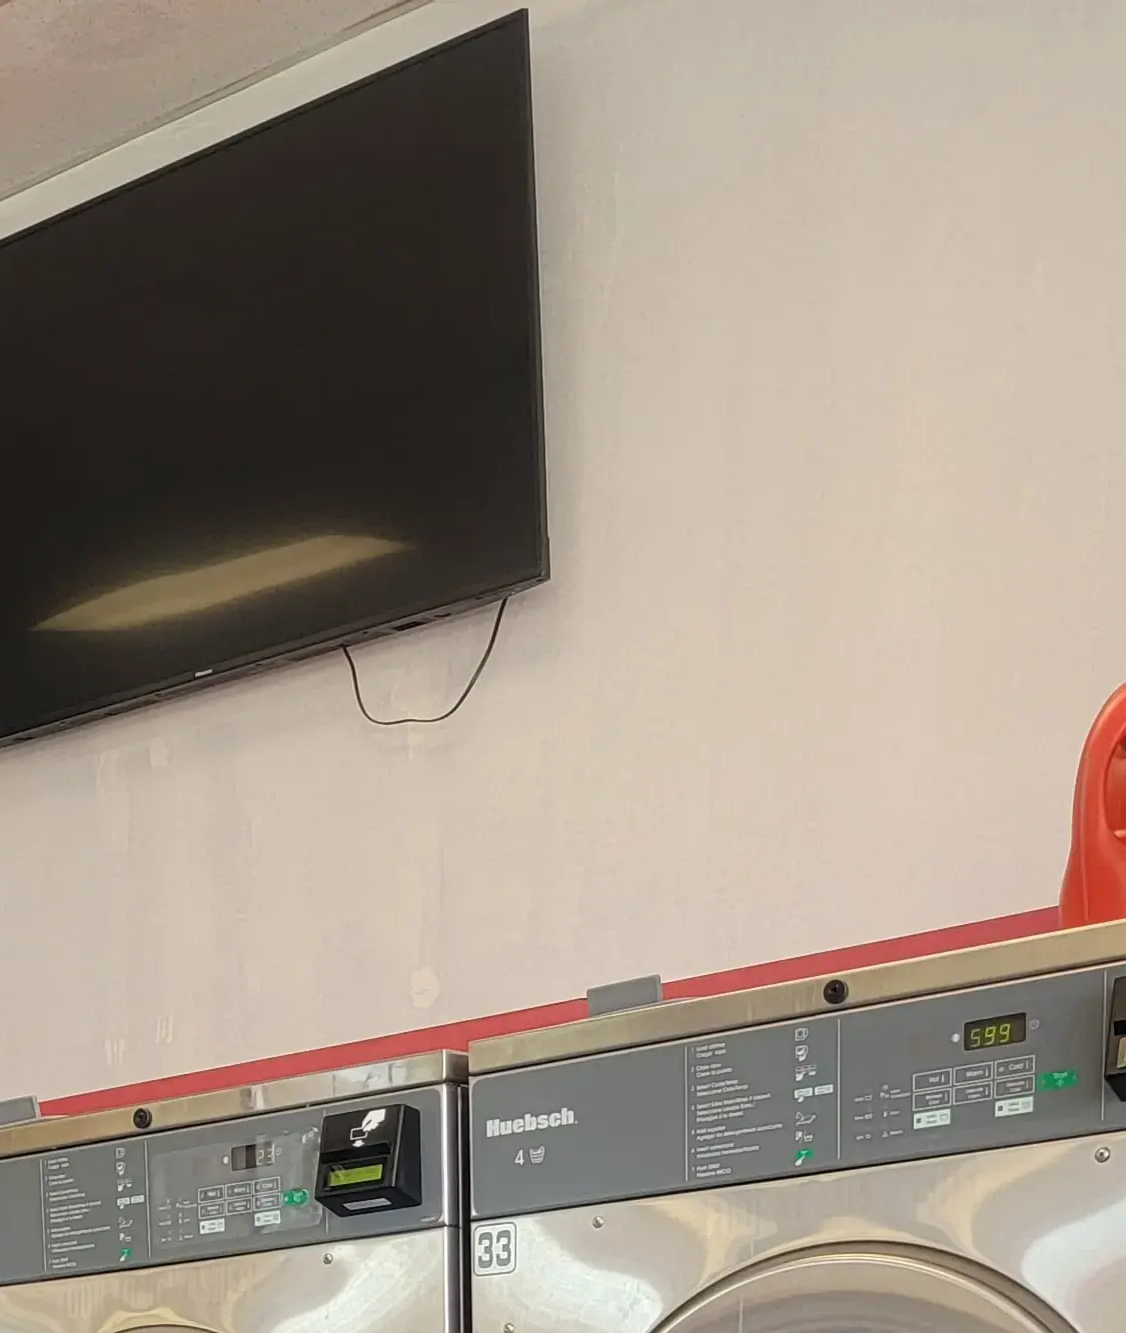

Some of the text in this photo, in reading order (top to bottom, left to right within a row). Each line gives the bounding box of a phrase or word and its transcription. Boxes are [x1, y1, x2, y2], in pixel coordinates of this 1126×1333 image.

[486, 1107, 575, 1138] Huebsch
[514, 1149, 525, 1166] 4
[477, 1229, 512, 1269] 33
